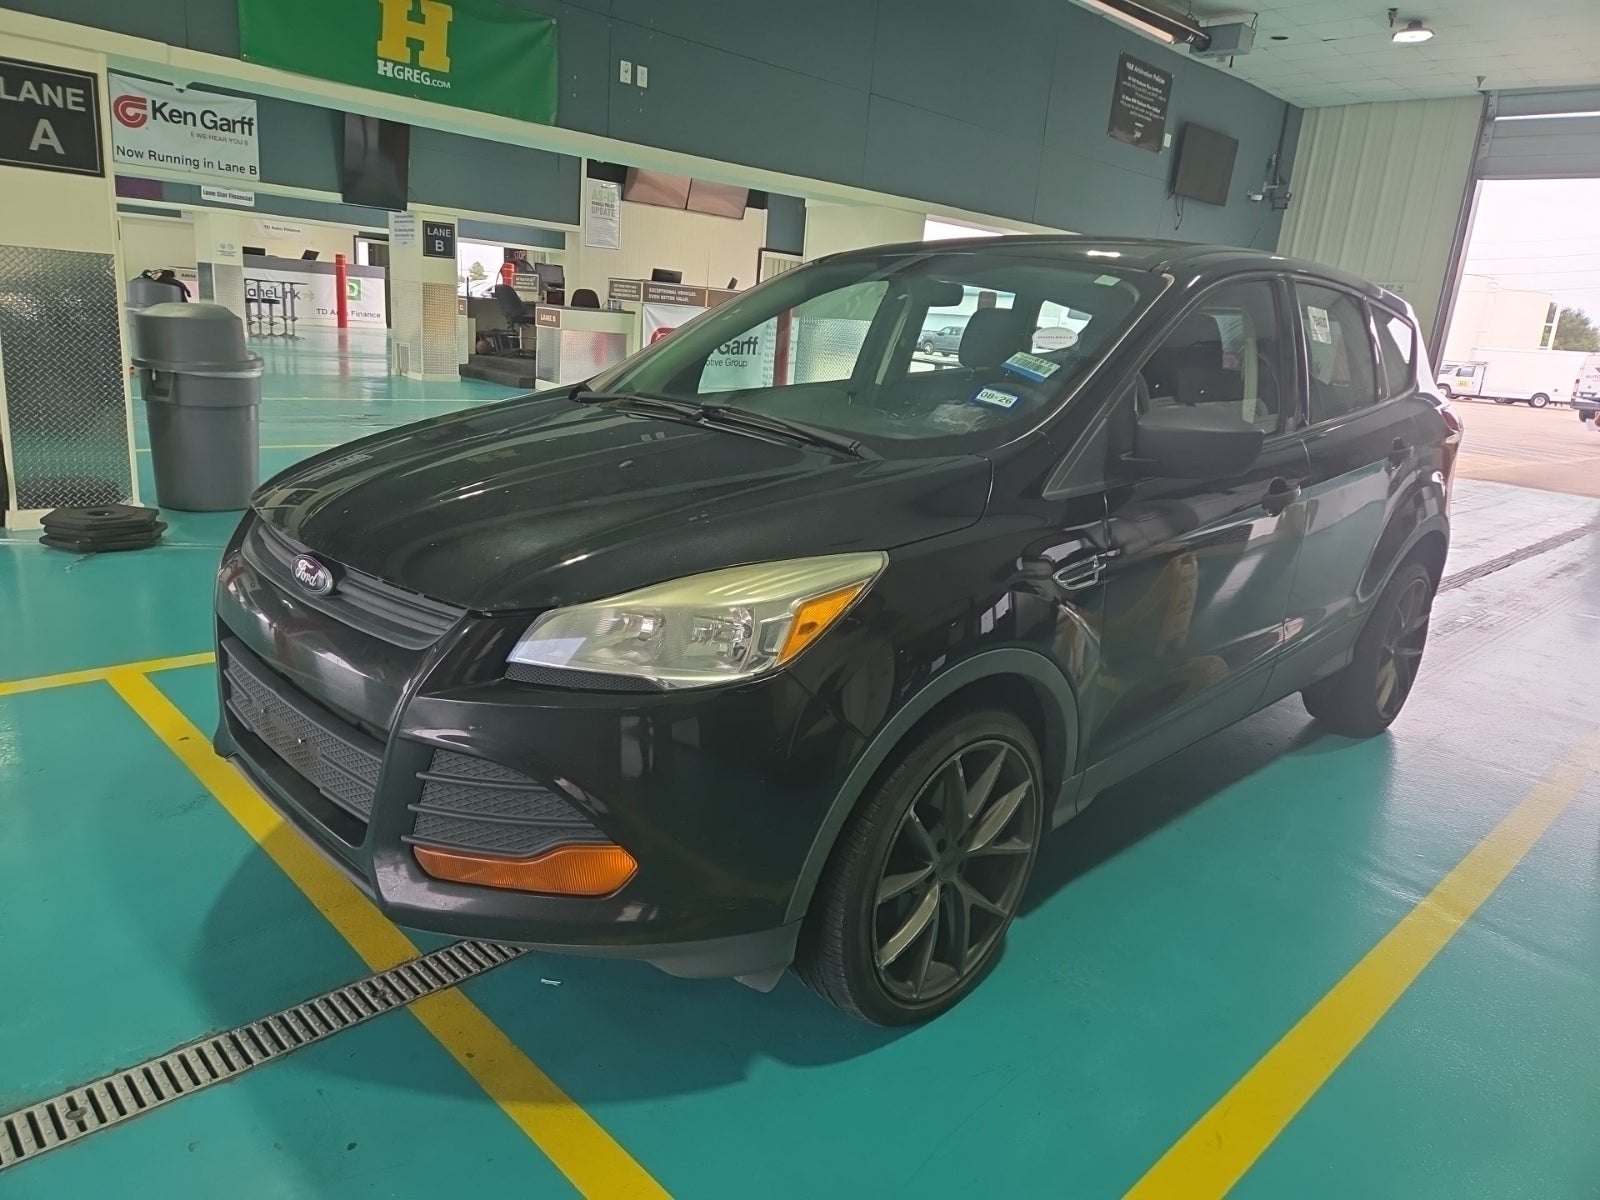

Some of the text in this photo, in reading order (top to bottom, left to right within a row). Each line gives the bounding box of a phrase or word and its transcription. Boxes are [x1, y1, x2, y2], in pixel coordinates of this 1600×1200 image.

[0, 75, 86, 112] LANE
[151, 99, 254, 136] Ken Garff
[29, 118, 66, 155] A
[116, 145, 258, 175] Now Running in Lane B
[427, 227, 452, 238] LANE
[435, 239, 445, 252] B
[316, 308, 328, 316] TD
[351, 310, 381, 319] Finance
[717, 336, 759, 355] Garff
[725, 358, 748, 369] Group
[295, 559, 319, 587] Ford
